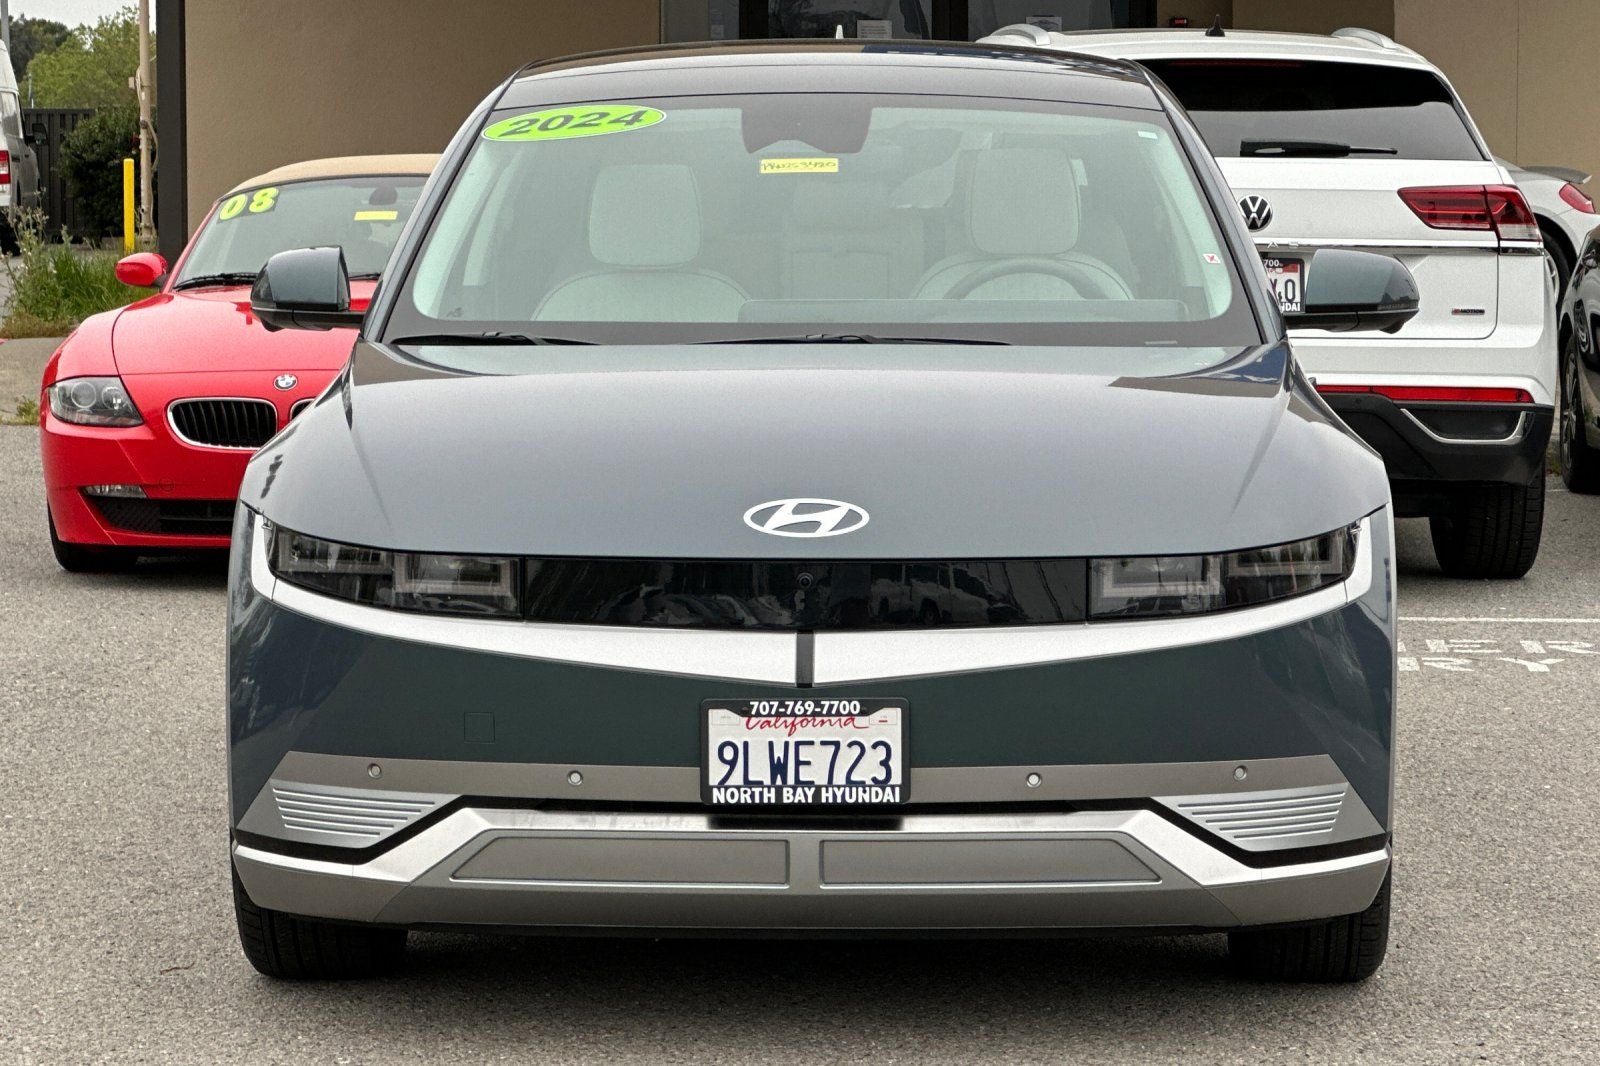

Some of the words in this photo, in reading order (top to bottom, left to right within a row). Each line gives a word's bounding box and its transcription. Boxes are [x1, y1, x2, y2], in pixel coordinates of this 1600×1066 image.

[498, 109, 648, 137] 2024
[219, 187, 279, 221] 08
[750, 701, 861, 716] 707-769-7700
[745, 715, 869, 737] California
[717, 740, 893, 786] 9LWE723
[712, 787, 776, 803] NORTH
[782, 787, 816, 803] BAY
[821, 787, 901, 803] HYUNDAI
